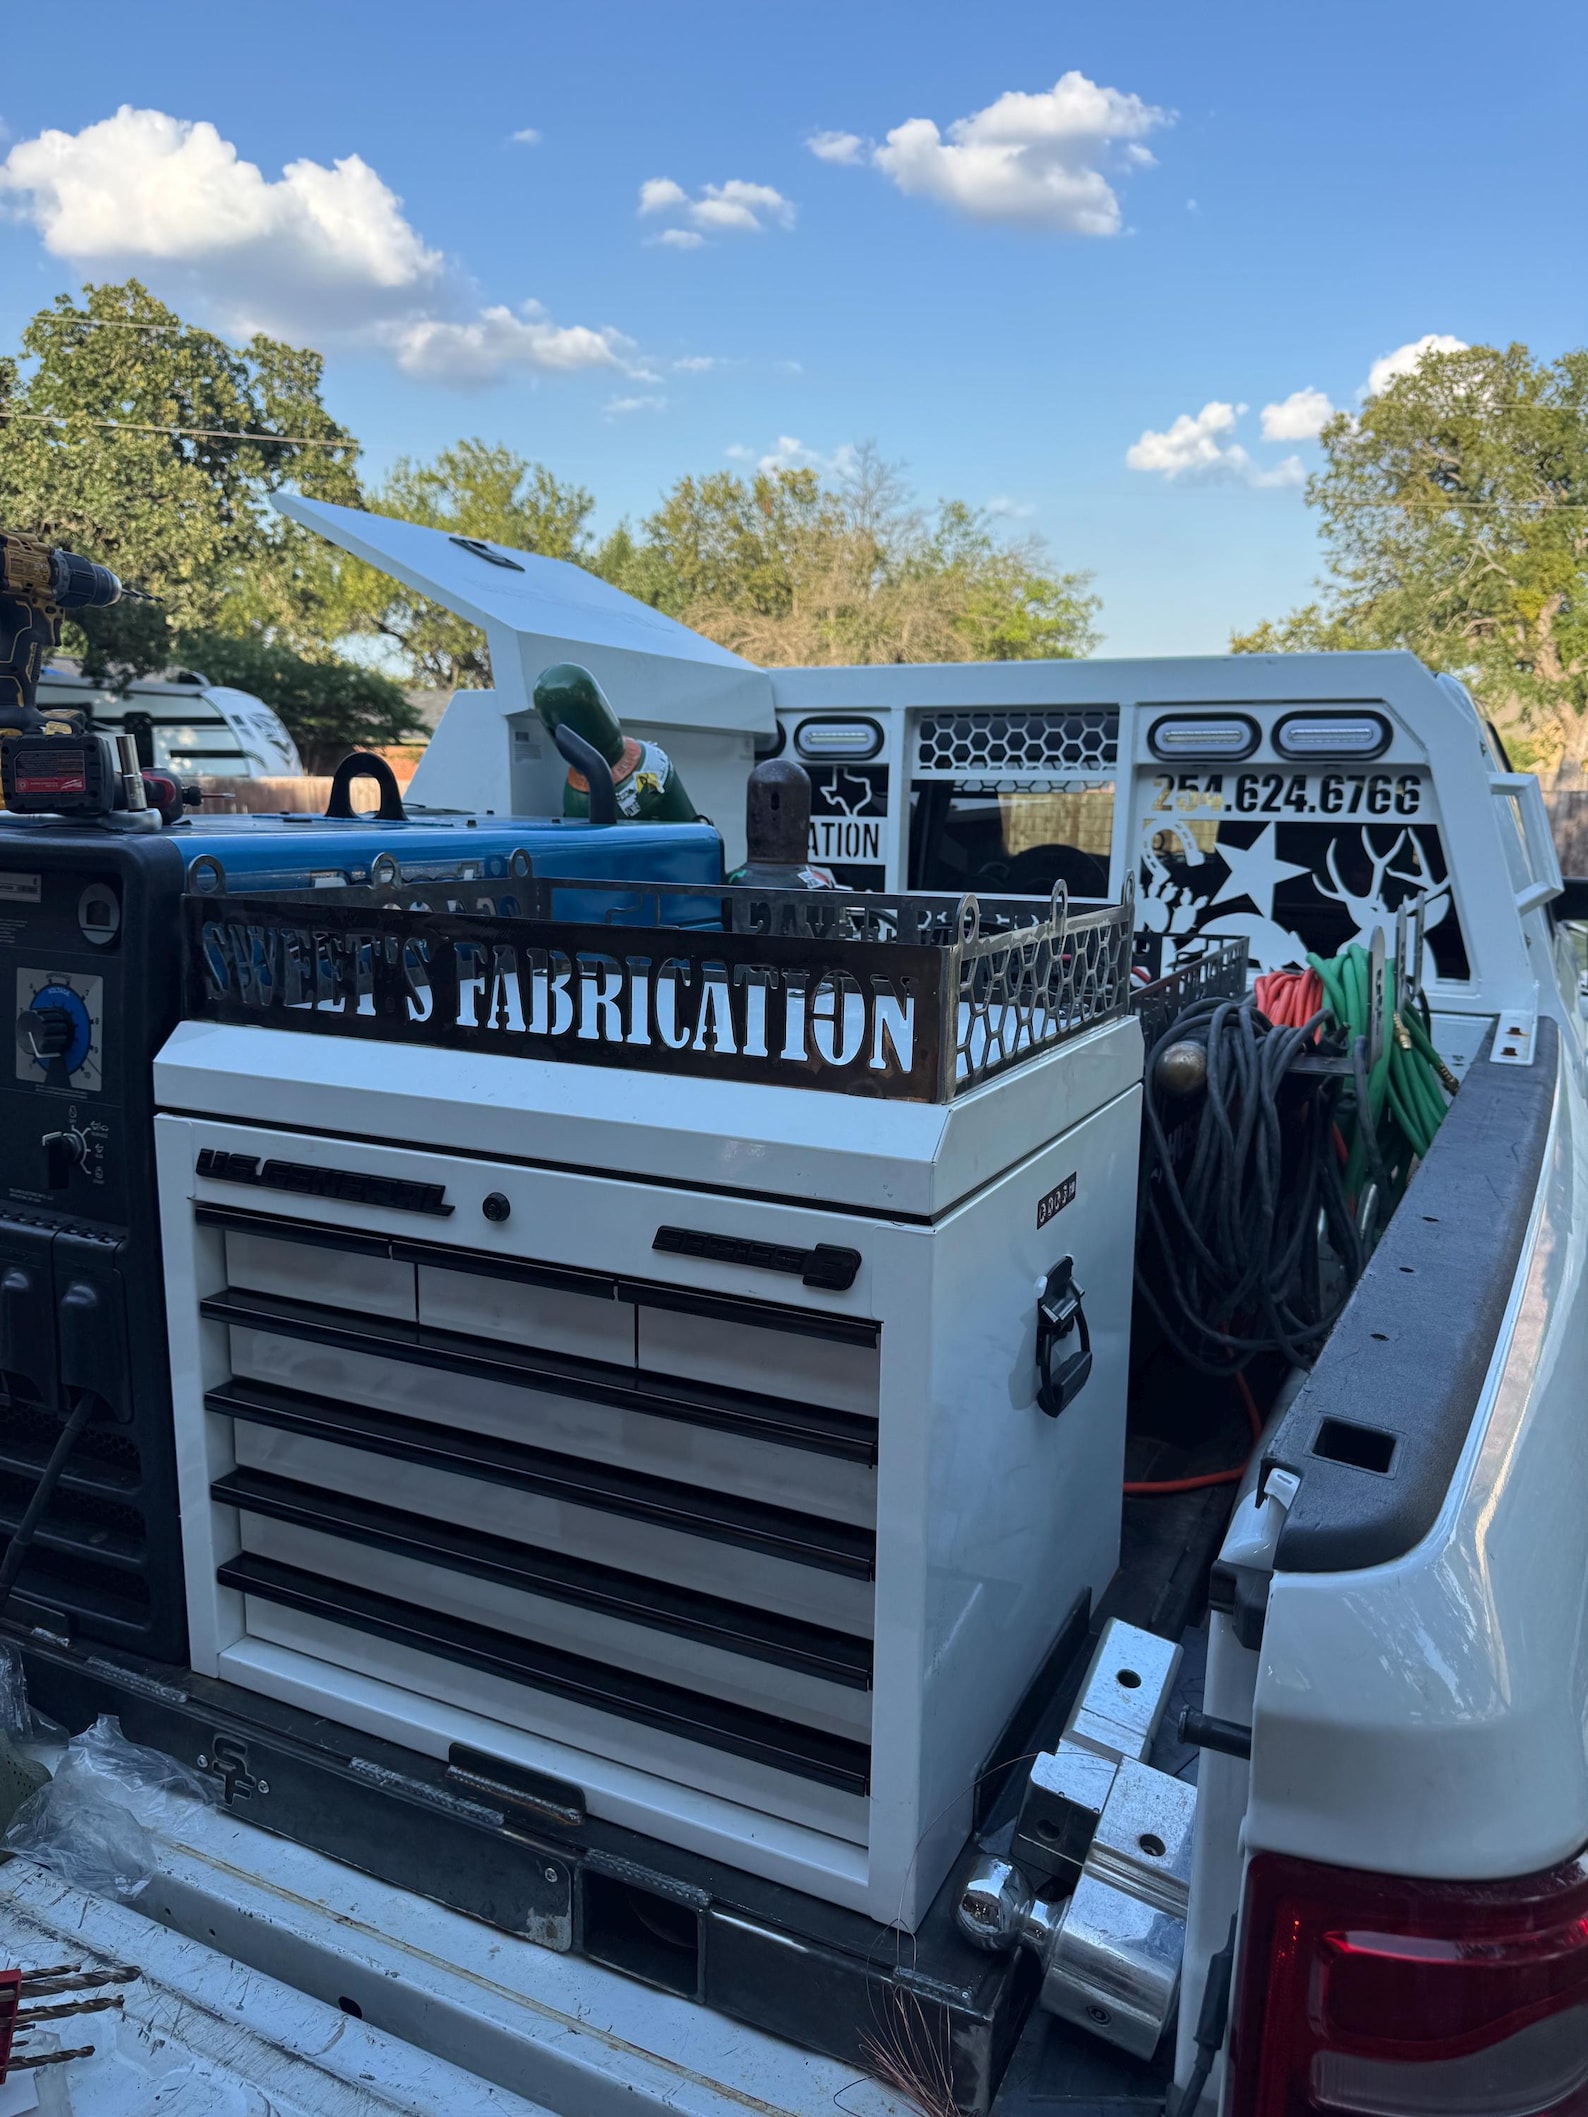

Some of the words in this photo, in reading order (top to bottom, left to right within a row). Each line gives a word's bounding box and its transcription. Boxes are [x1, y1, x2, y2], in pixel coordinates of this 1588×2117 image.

[1151, 773, 1422, 815] 254.624.6766
[202, 920, 434, 1022] SWEET'S
[454, 942, 918, 1074] FABRICATION
